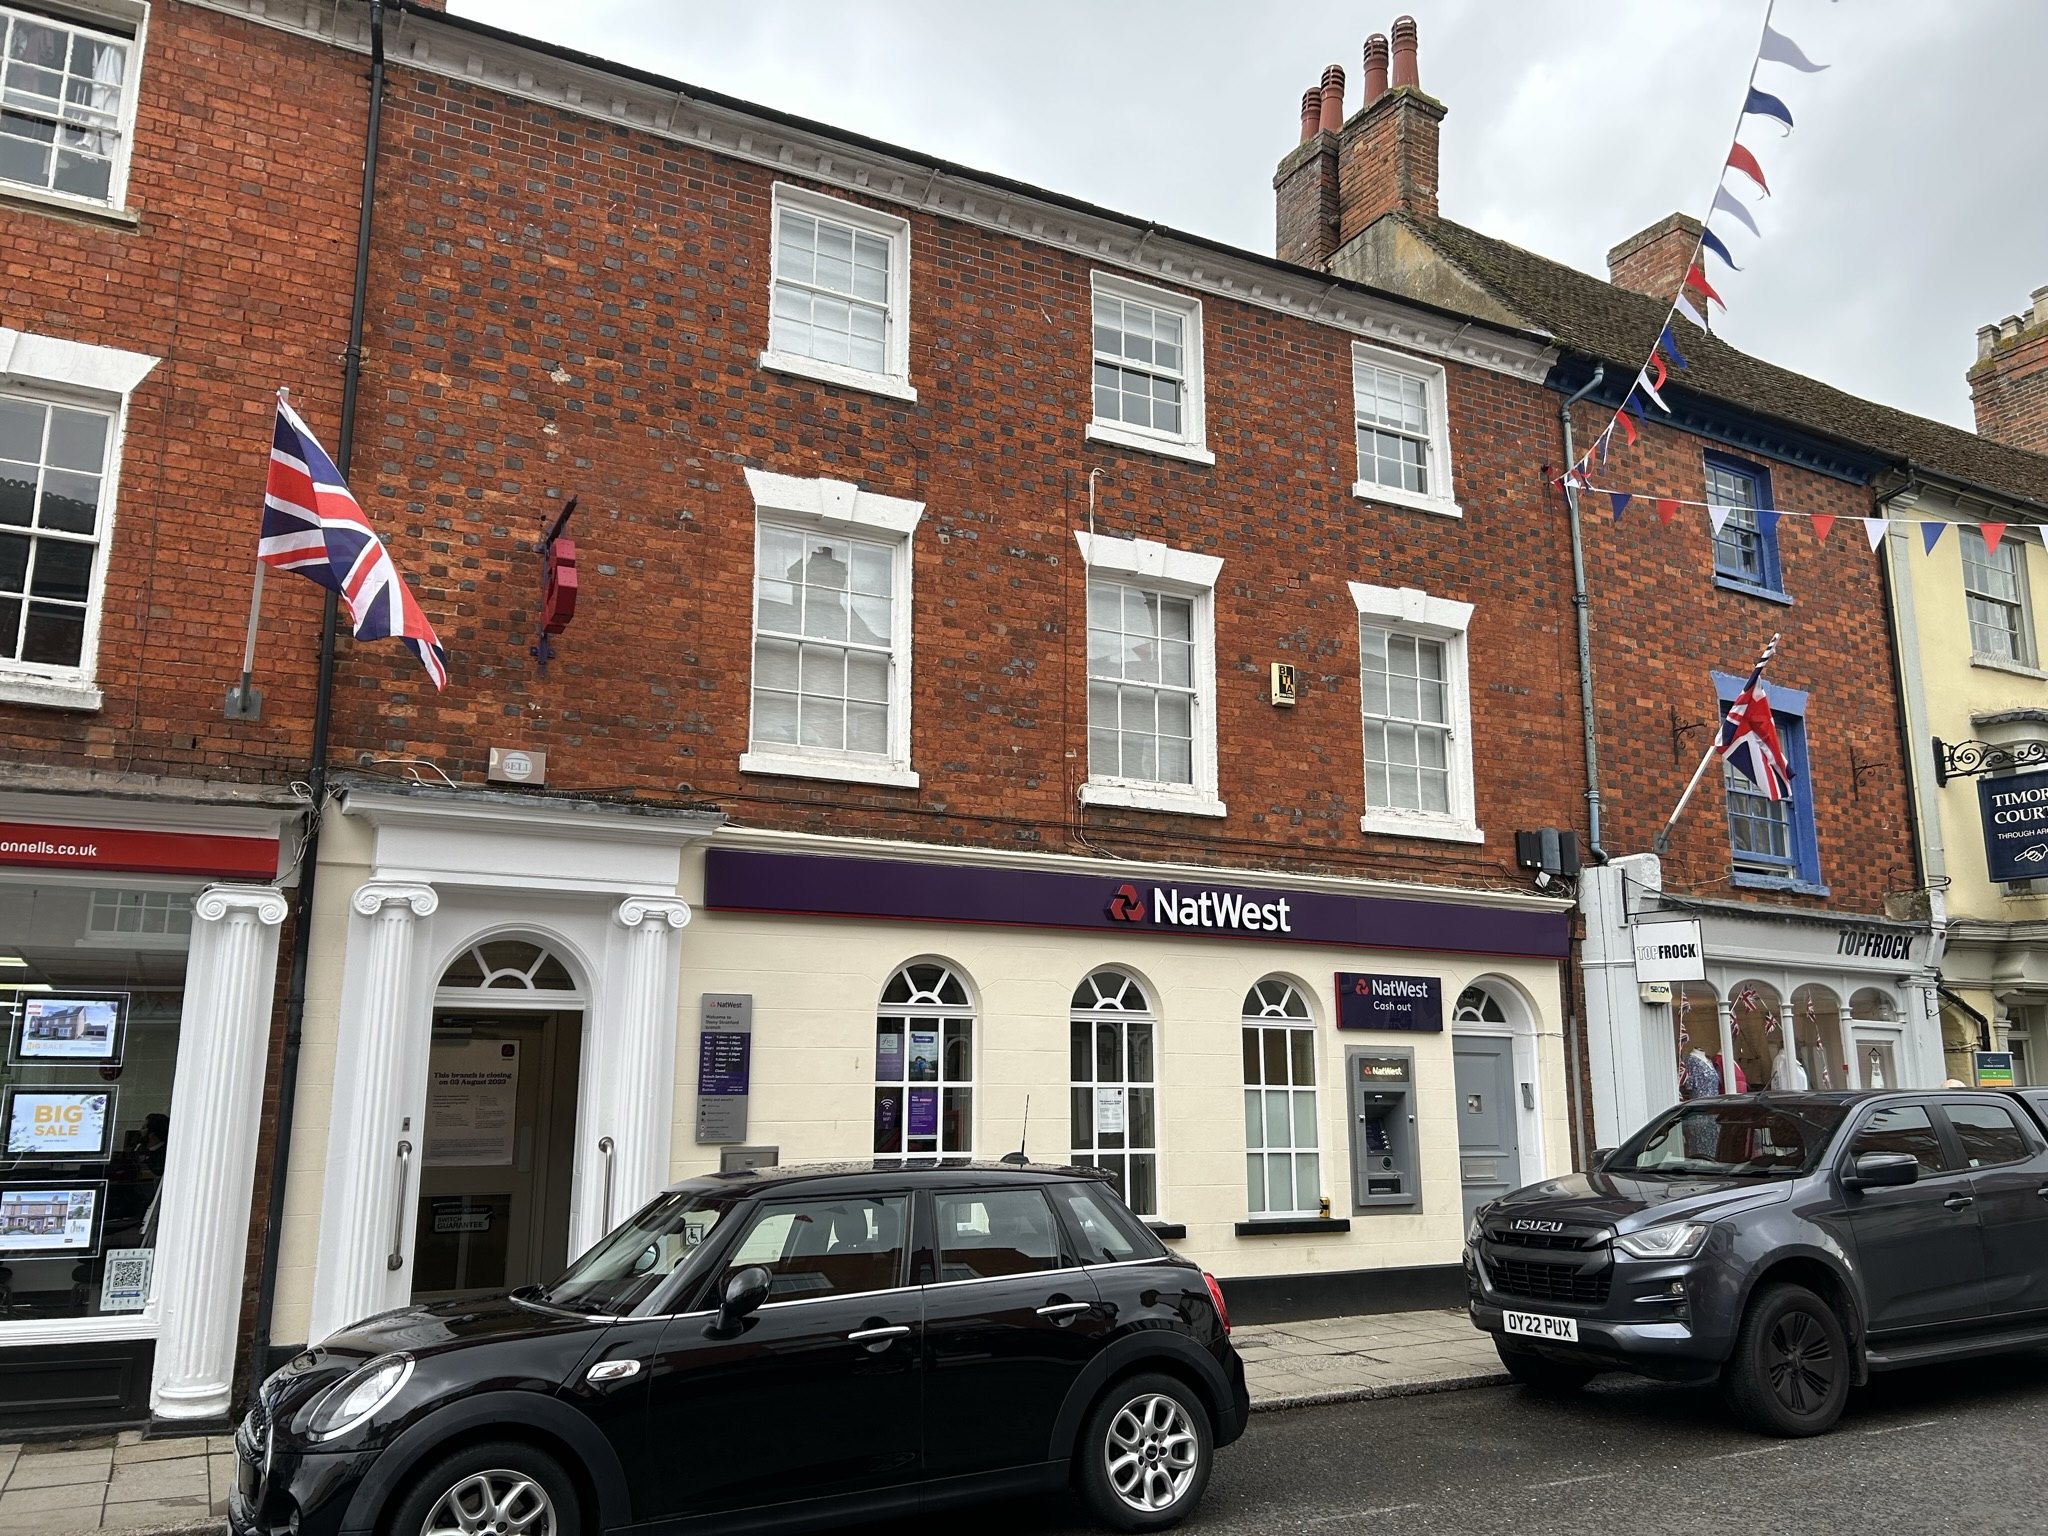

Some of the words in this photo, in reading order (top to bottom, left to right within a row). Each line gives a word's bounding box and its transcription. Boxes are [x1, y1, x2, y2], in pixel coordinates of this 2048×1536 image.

[1991, 787, 2048, 807] TIMOR
[1997, 830, 2035, 840] THROUGH
[2036, 827, 2048, 835] AR
[0, 841, 97, 857] onnells.co.uk
[1154, 887, 1292, 932] NatWest
[1837, 930, 1914, 960] TOPFROCK
[1372, 979, 1429, 998] NatWest
[1650, 985, 1670, 994] SECOM
[716, 1001, 743, 1009] NatWest
[1373, 1000, 1395, 1011] Cash
[1396, 1002, 1412, 1012] out
[486, 1072, 512, 1080] closing
[1372, 1066, 1403, 1076] NatWest
[33, 1104, 83, 1123] BIG
[34, 1125, 79, 1136] SALE
[437, 1222, 483, 1230] GUARANTEE
[1515, 1219, 1563, 1233] ISUZU
[1508, 1313, 1542, 1334] OY22
[1544, 1319, 1572, 1338] PUX
